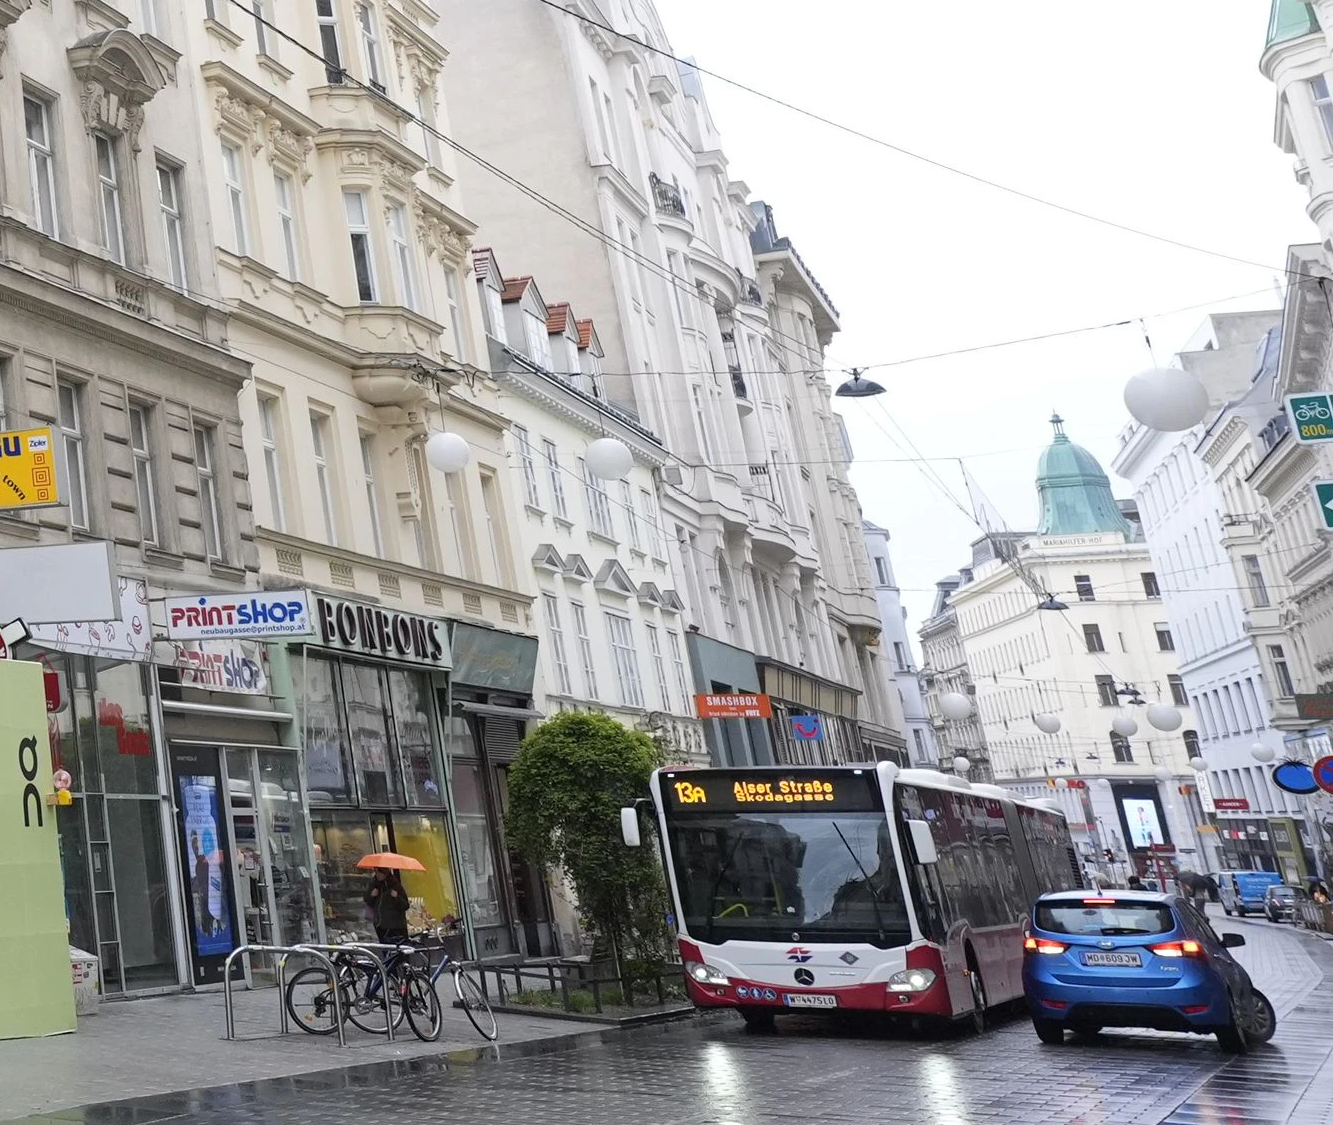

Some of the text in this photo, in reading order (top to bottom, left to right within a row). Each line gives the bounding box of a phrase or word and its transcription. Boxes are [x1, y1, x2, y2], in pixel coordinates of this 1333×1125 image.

[2, 475, 26, 501] town
[200, 623, 306, 635] neubaugasse@printshop.at
[317, 598, 443, 661] BONBONS
[706, 696, 759, 706] SMASHBOX
[674, 781, 707, 803] 13A
[733, 780, 833, 794] Alser Straße
[736, 792, 835, 803] Skodagasse
